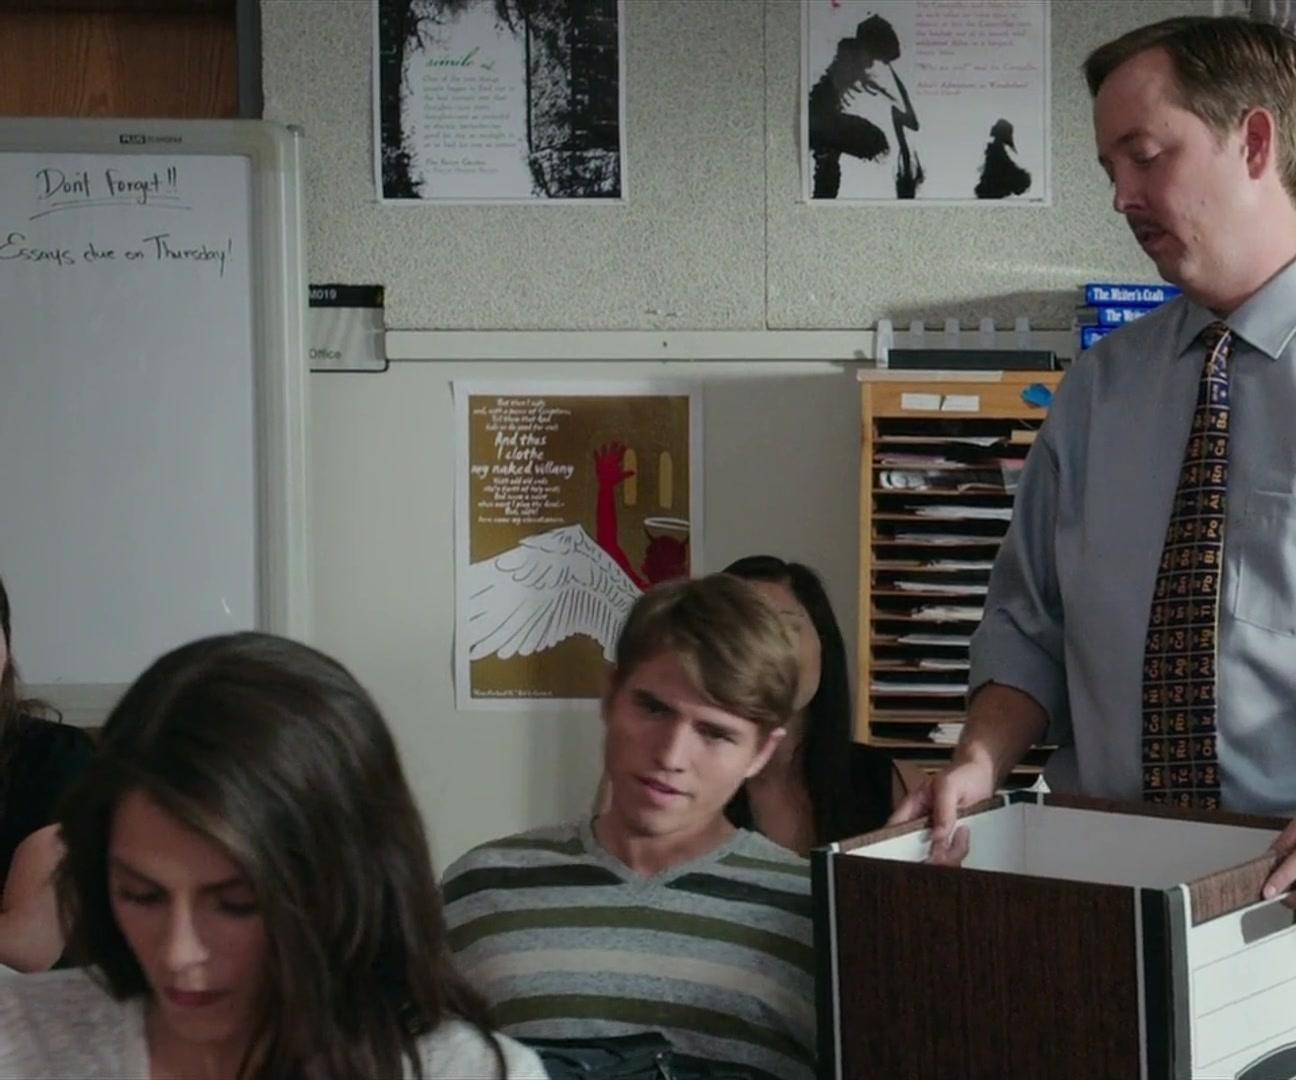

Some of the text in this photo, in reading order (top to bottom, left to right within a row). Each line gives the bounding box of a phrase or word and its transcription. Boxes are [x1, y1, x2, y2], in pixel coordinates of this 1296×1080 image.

[0, 232, 77, 265] Essays
[85, 242, 116, 263] due
[125, 250, 145, 260] on
[1093, 287, 1110, 301] The
[1105, 308, 1122, 322] The
[309, 348, 342, 360] Office
[494, 430, 547, 447] And thus
[505, 447, 544, 460] clothe
[470, 464, 489, 479] my
[492, 459, 534, 475] naked
